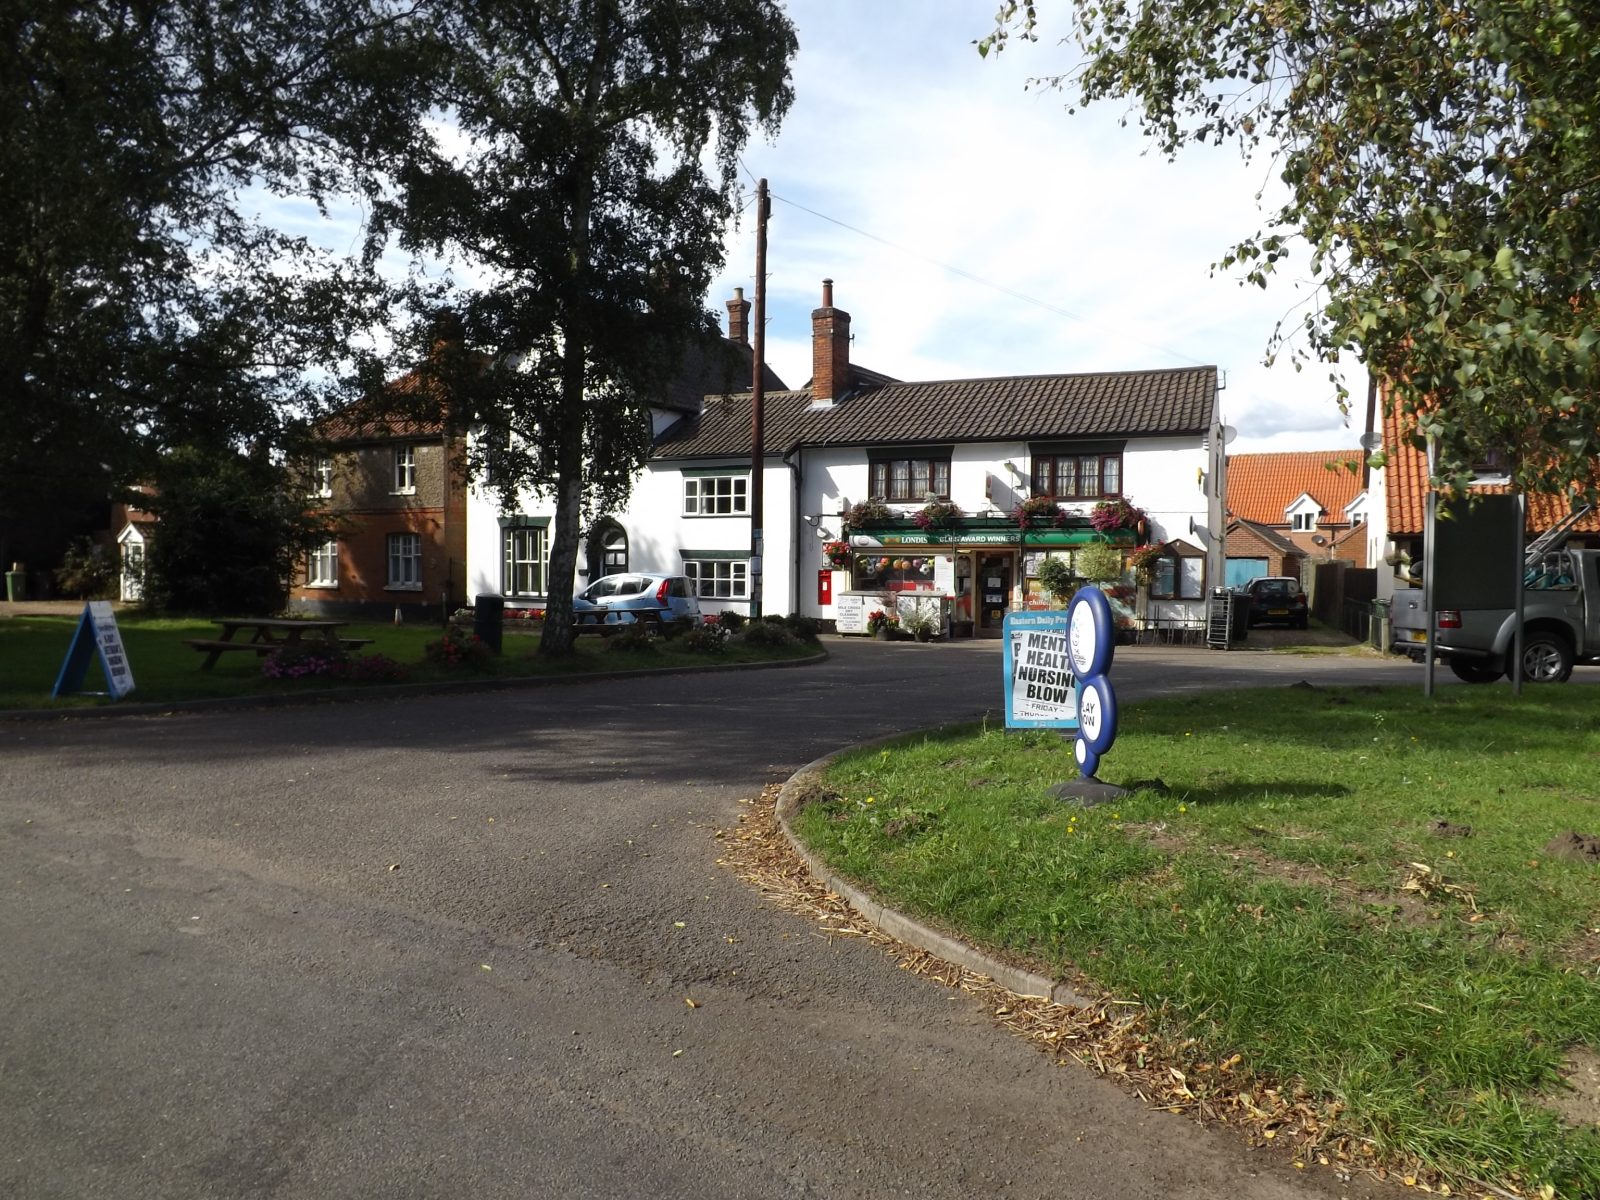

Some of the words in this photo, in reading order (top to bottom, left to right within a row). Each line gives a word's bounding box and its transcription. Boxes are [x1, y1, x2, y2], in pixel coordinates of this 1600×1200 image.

[901, 536, 928, 544] LONDIS
[960, 535, 986, 543] AWARD
[987, 535, 1020, 543] WINNERS
[1010, 617, 1035, 626] Eastern
[1036, 616, 1055, 627] Daily
[1027, 633, 1067, 654] MENT
[1026, 650, 1071, 670] HEALT
[1026, 684, 1068, 704] BLOW
[1031, 702, 1059, 713] FRIDAY
